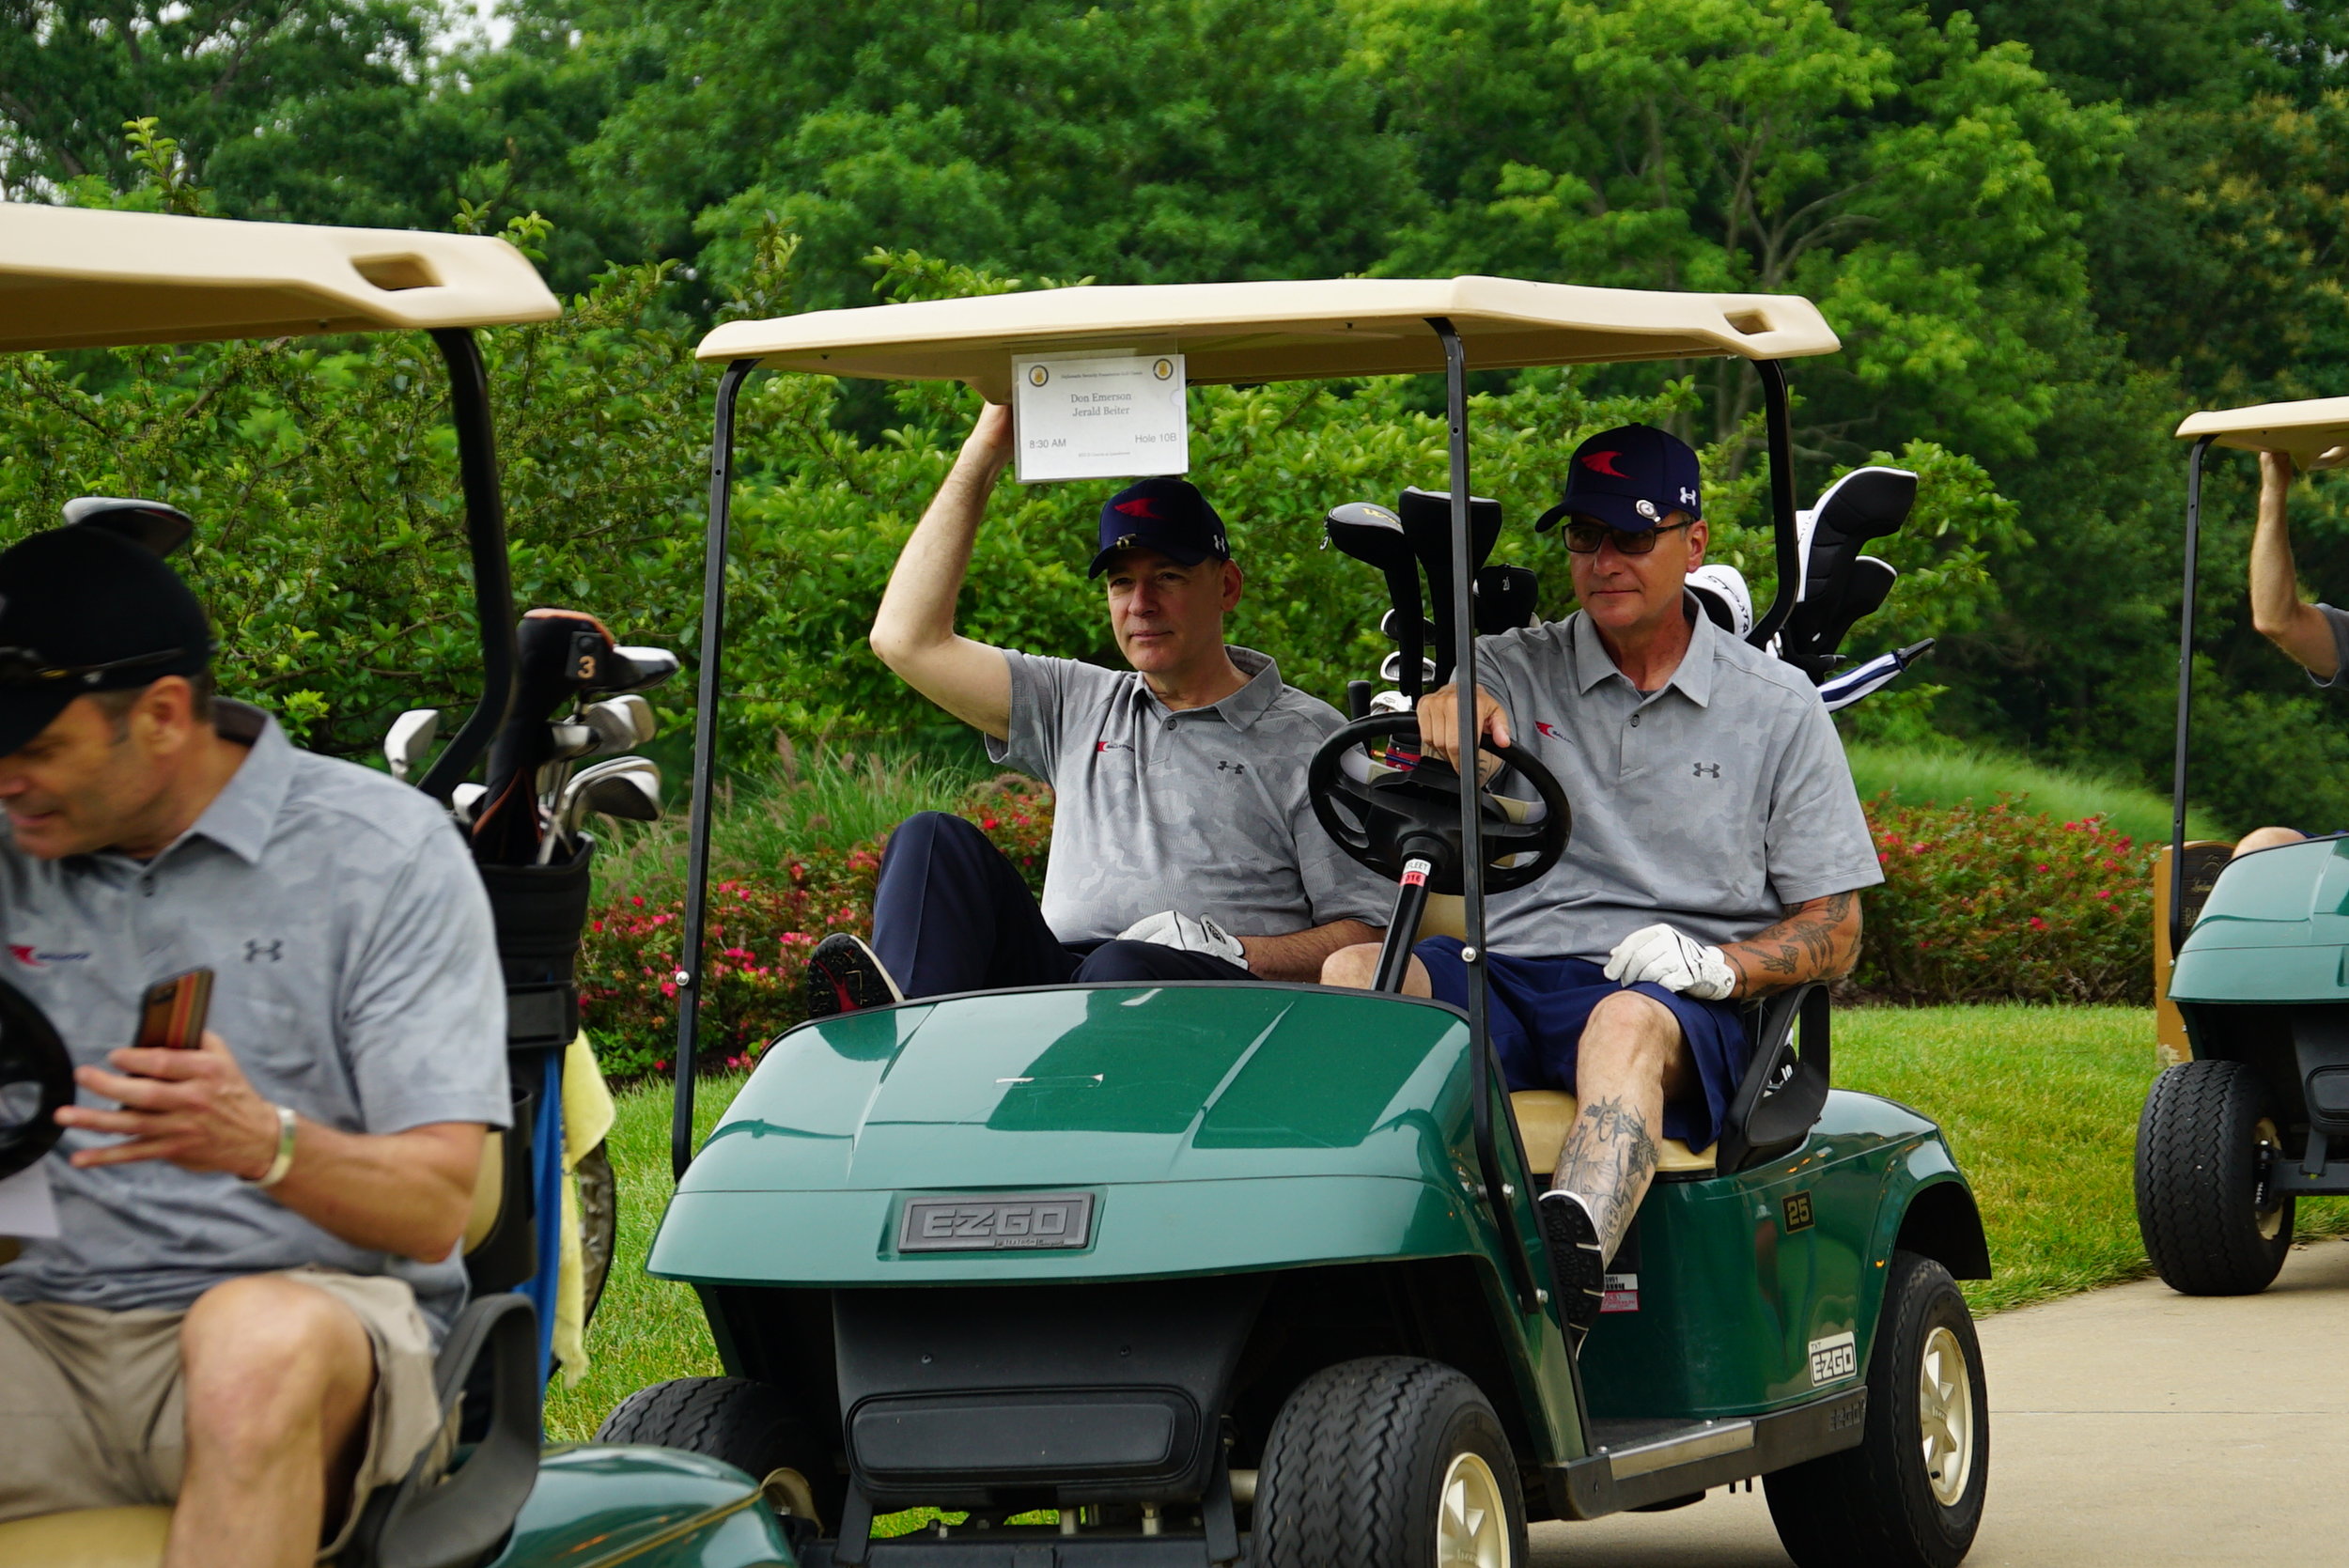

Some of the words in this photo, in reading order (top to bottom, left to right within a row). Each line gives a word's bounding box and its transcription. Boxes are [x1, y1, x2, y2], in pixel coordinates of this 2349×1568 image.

[1071, 394, 1090, 403] Don
[1092, 393, 1131, 402] Emerson
[1072, 407, 1101, 416] Jerald
[1029, 439, 1049, 449] 8:30
[1051, 438, 1066, 448] AM
[1135, 434, 1156, 443] Hole
[578, 656, 596, 678] 3
[1787, 1197, 1810, 1226] 25
